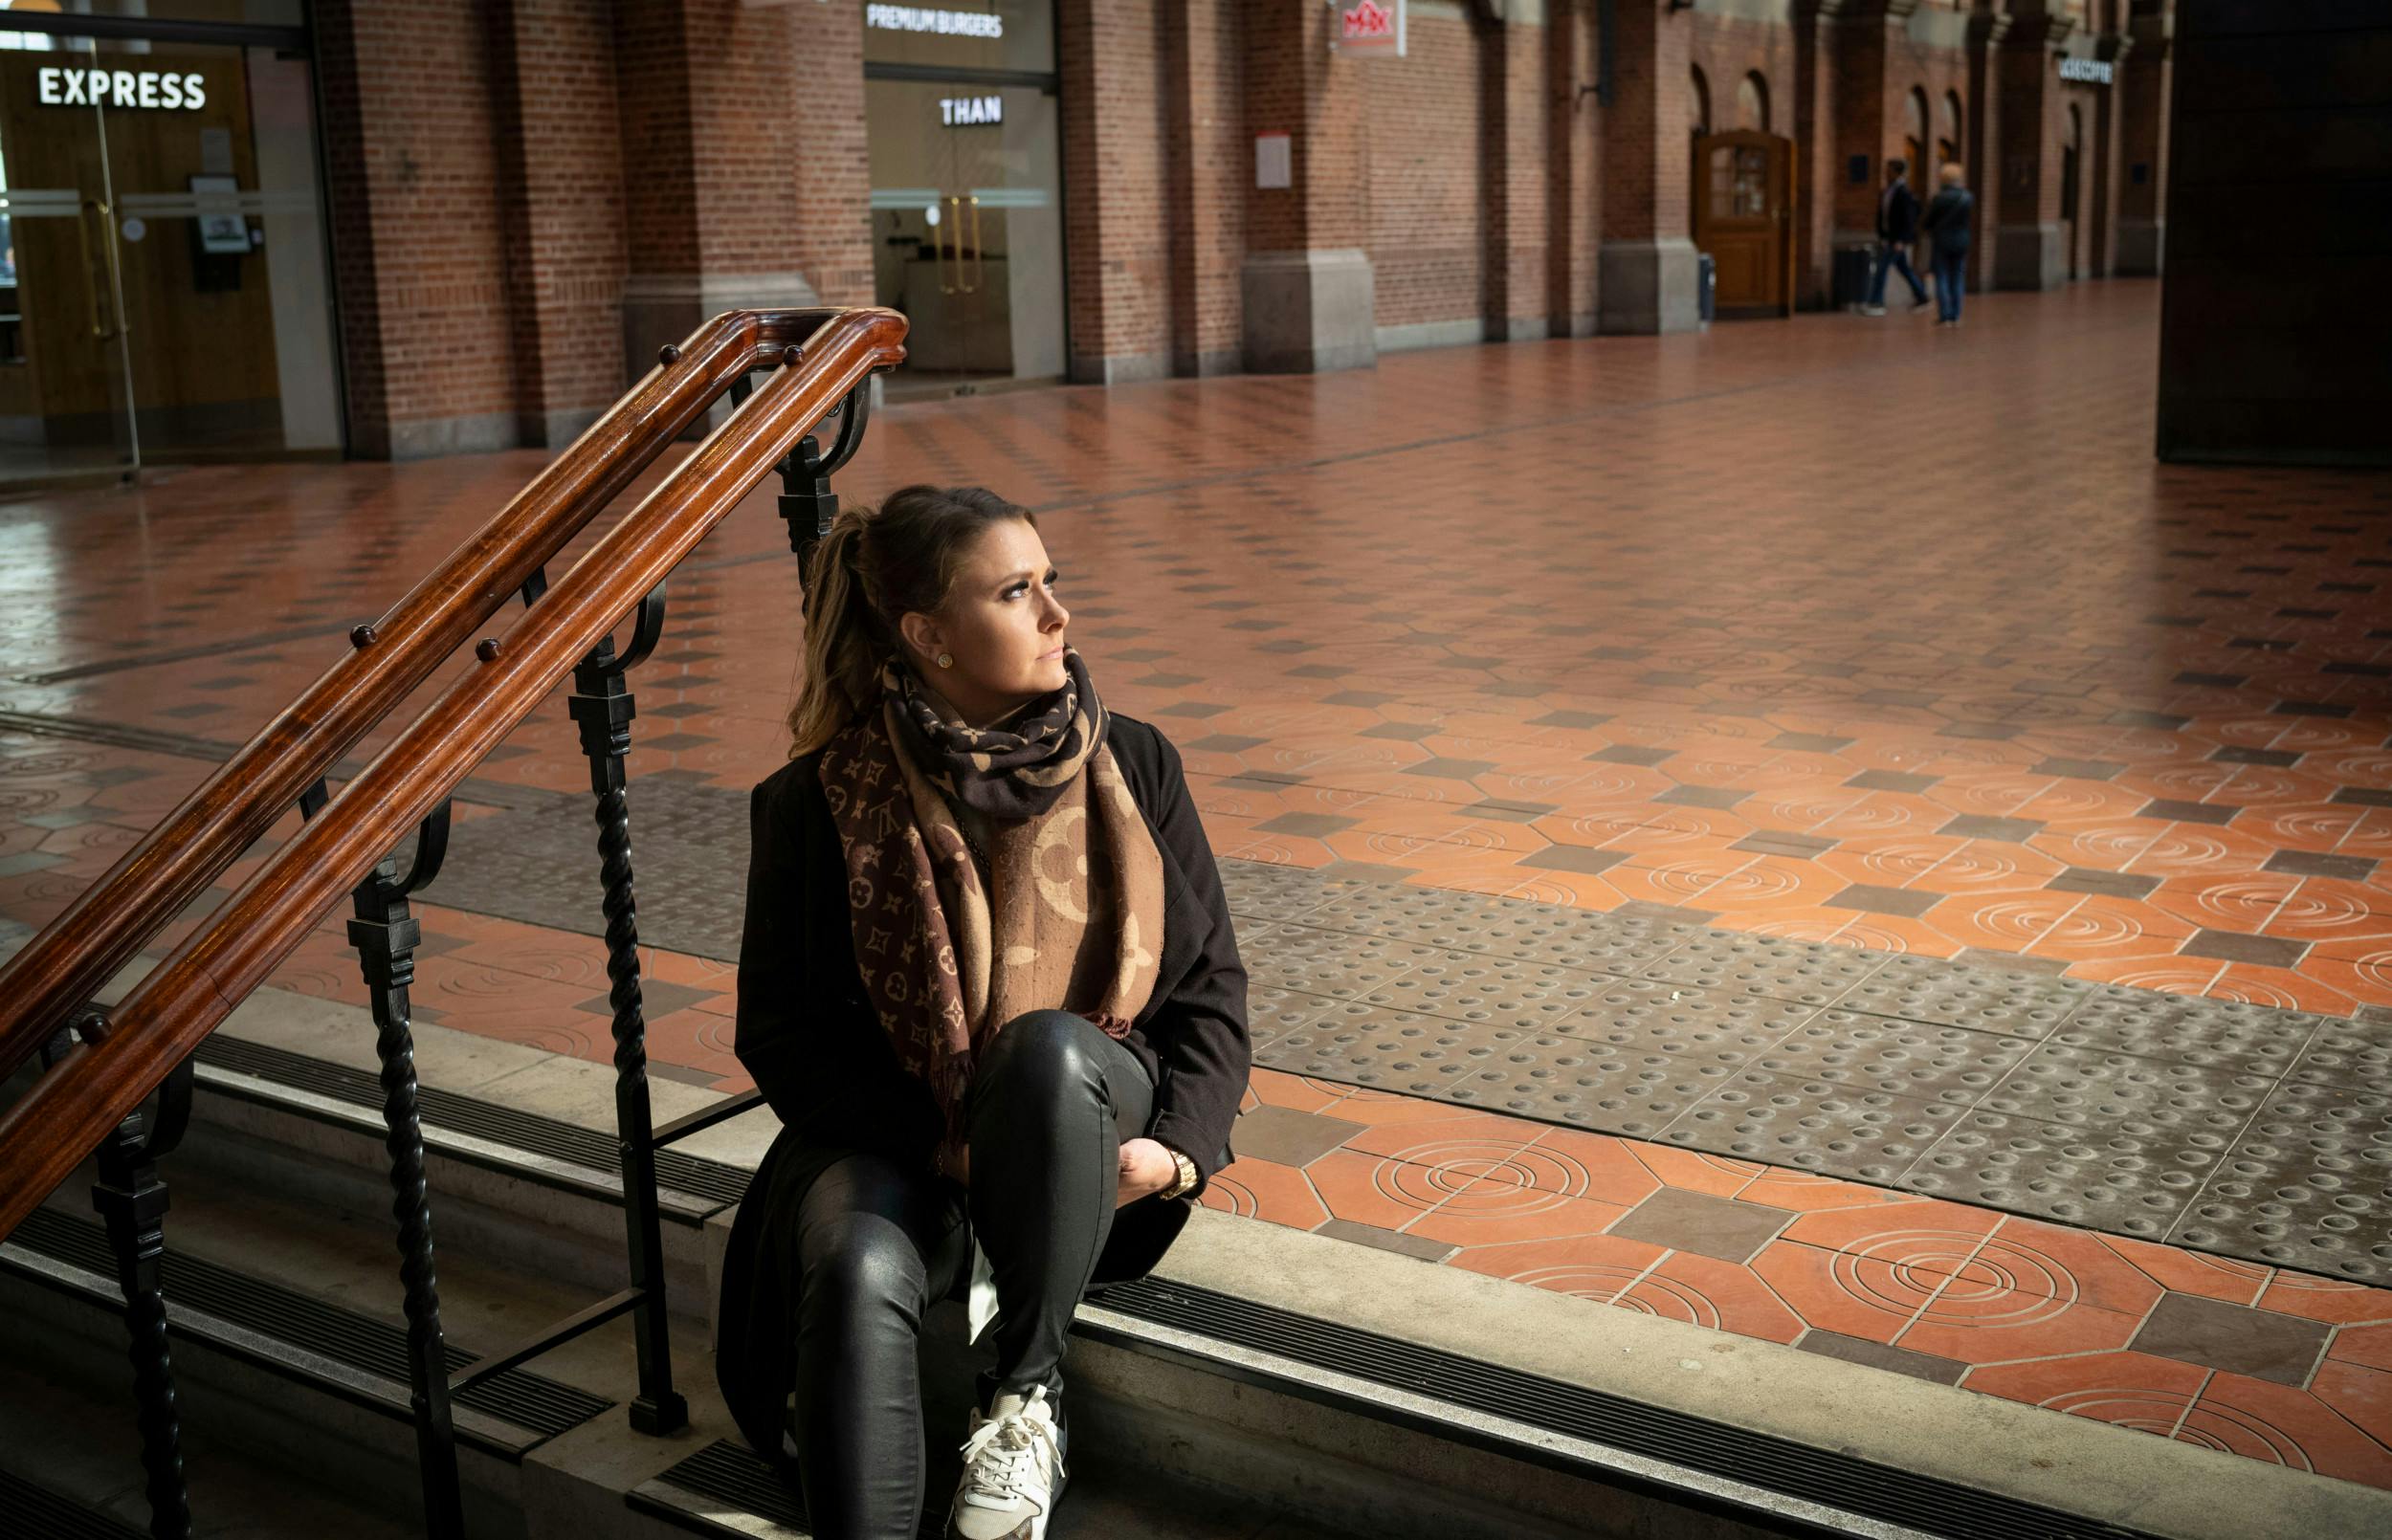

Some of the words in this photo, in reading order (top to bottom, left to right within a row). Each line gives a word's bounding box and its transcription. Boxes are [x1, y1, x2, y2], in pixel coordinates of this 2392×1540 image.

[867, 4, 936, 32] PREMIUM
[937, 10, 1003, 38] BURGERS
[39, 68, 206, 109] EXPRESS
[940, 96, 1002, 125] THAN
